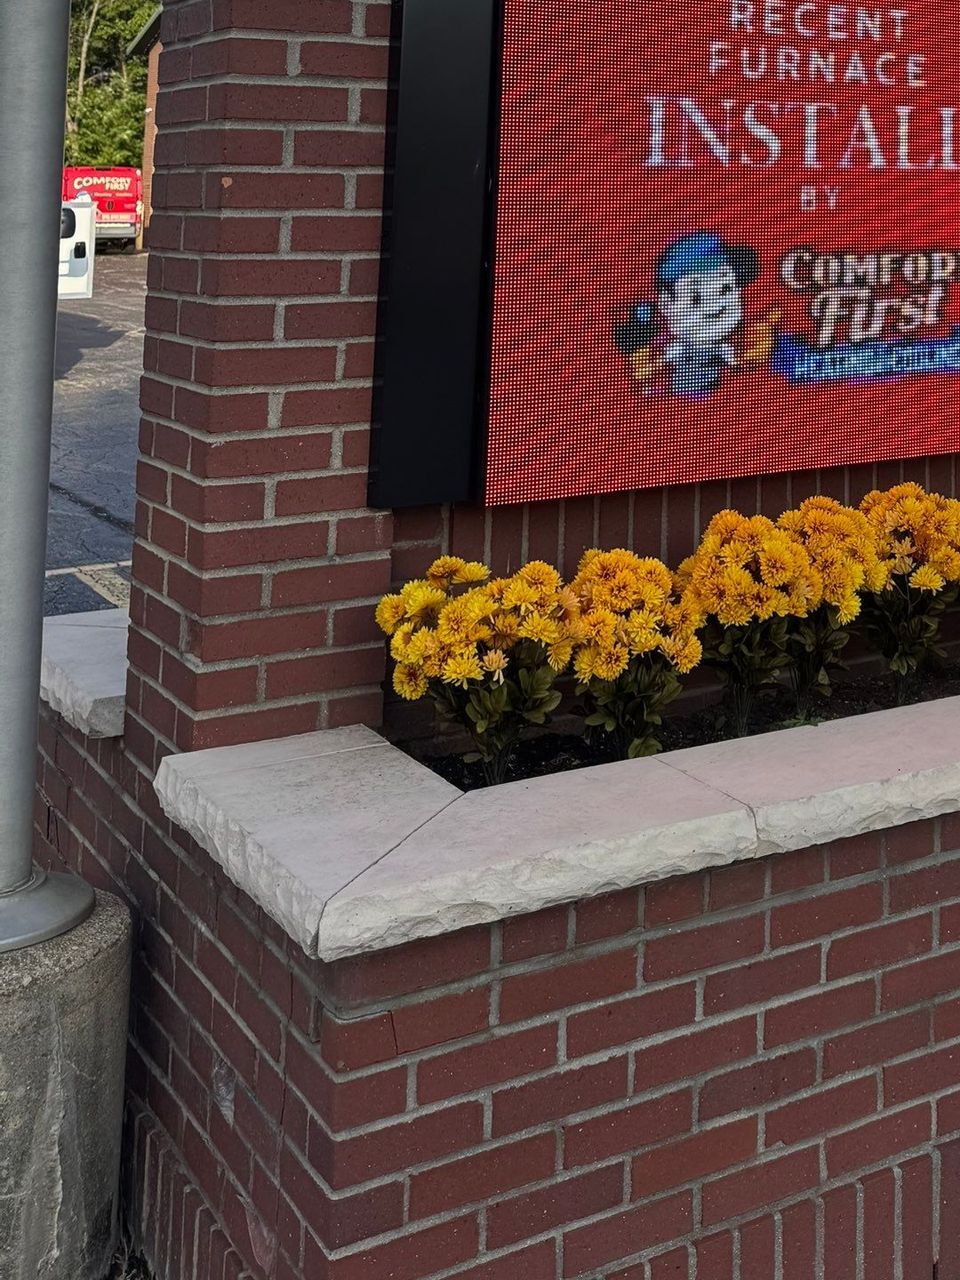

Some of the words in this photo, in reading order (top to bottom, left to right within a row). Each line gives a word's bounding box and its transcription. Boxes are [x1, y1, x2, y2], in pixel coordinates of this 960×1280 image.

[709, 41, 927, 87] FURNACE
[73, 176, 132, 189] COMFORT
[105, 182, 129, 190] FIRST
[800, 185, 840, 211] BY
[810, 285, 946, 347] First
